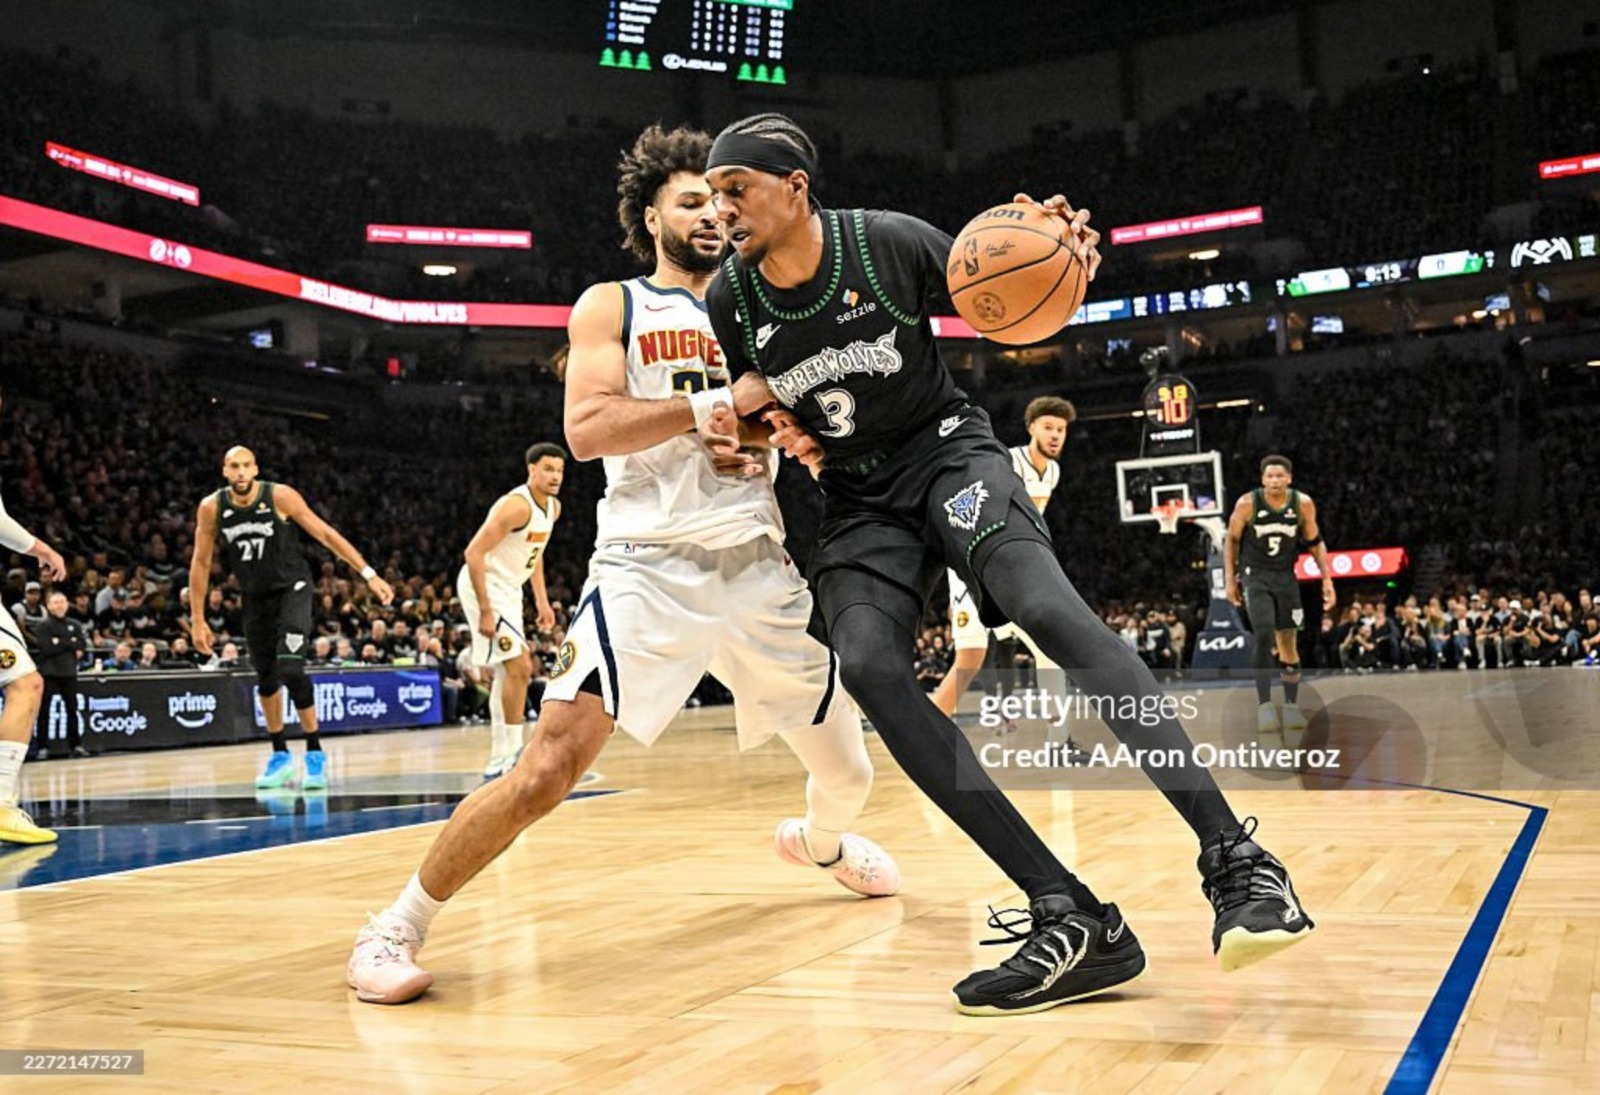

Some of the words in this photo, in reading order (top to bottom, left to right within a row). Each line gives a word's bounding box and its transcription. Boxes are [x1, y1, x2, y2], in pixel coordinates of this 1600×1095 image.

[1365, 263, 1402, 282] 9:13
[836, 302, 876, 325] sezzle
[813, 388, 856, 438] 3
[236, 538, 265, 560] 27
[525, 546, 539, 569] 2
[1267, 536, 1282, 557] 5
[168, 691, 216, 717] prime
[398, 682, 433, 704] prime
[347, 698, 388, 719] Google
[89, 710, 148, 736] Google
